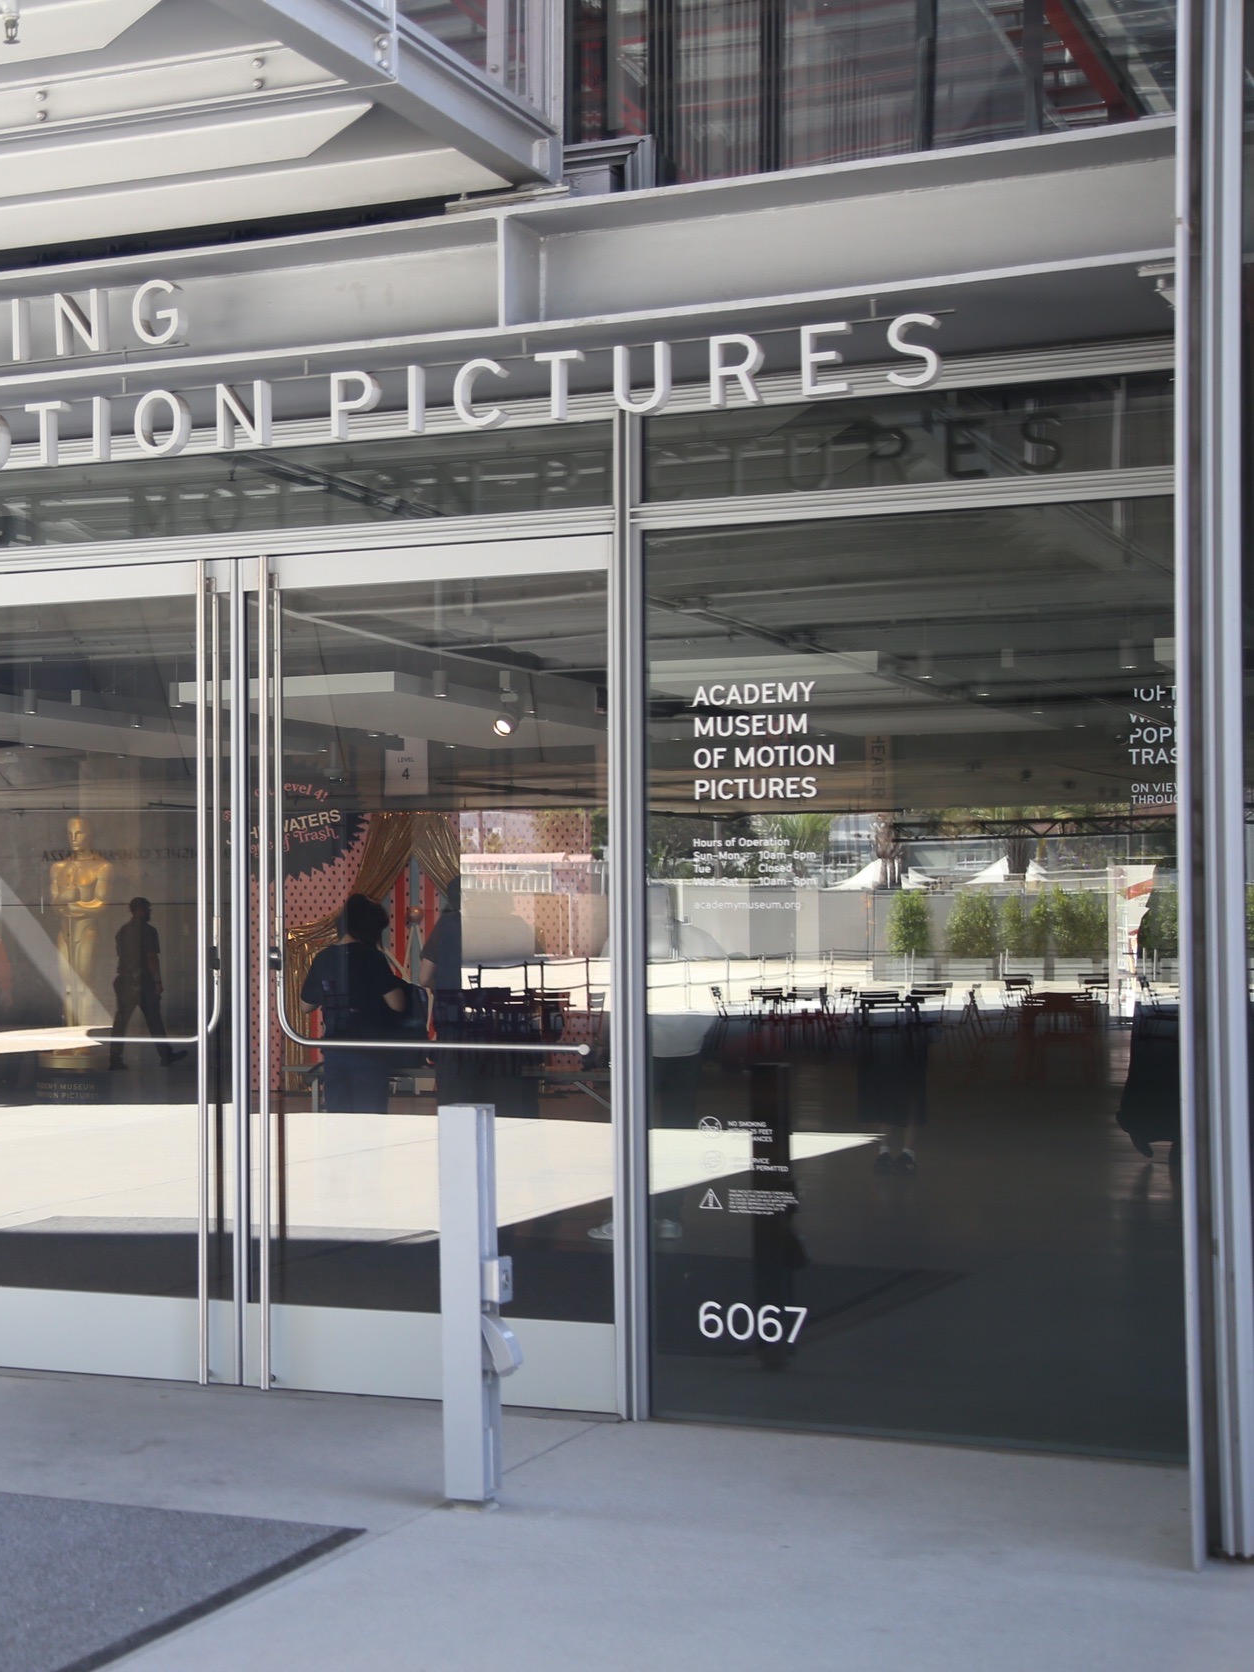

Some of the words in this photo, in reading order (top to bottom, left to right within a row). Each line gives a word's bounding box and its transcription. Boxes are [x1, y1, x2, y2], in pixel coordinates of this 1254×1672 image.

[330, 313, 944, 440] PICTURES
[692, 681, 816, 707] ACADEMY
[694, 713, 808, 738] MUSEUM
[693, 748, 727, 769] OF
[735, 744, 835, 768] MOTION
[402, 768, 410, 780] 4
[314, 789, 329, 802] 4!
[695, 777, 817, 800] PICTURES
[1131, 783, 1149, 793] ON
[293, 825, 340, 844] Trash
[693, 838, 722, 848] Hours
[725, 837, 736, 847] of
[738, 837, 790, 849] Operation
[693, 864, 711, 874] Tue
[758, 863, 793, 874] Closed
[694, 900, 802, 911] academymuseum.org
[698, 1301, 808, 1343] 6067
